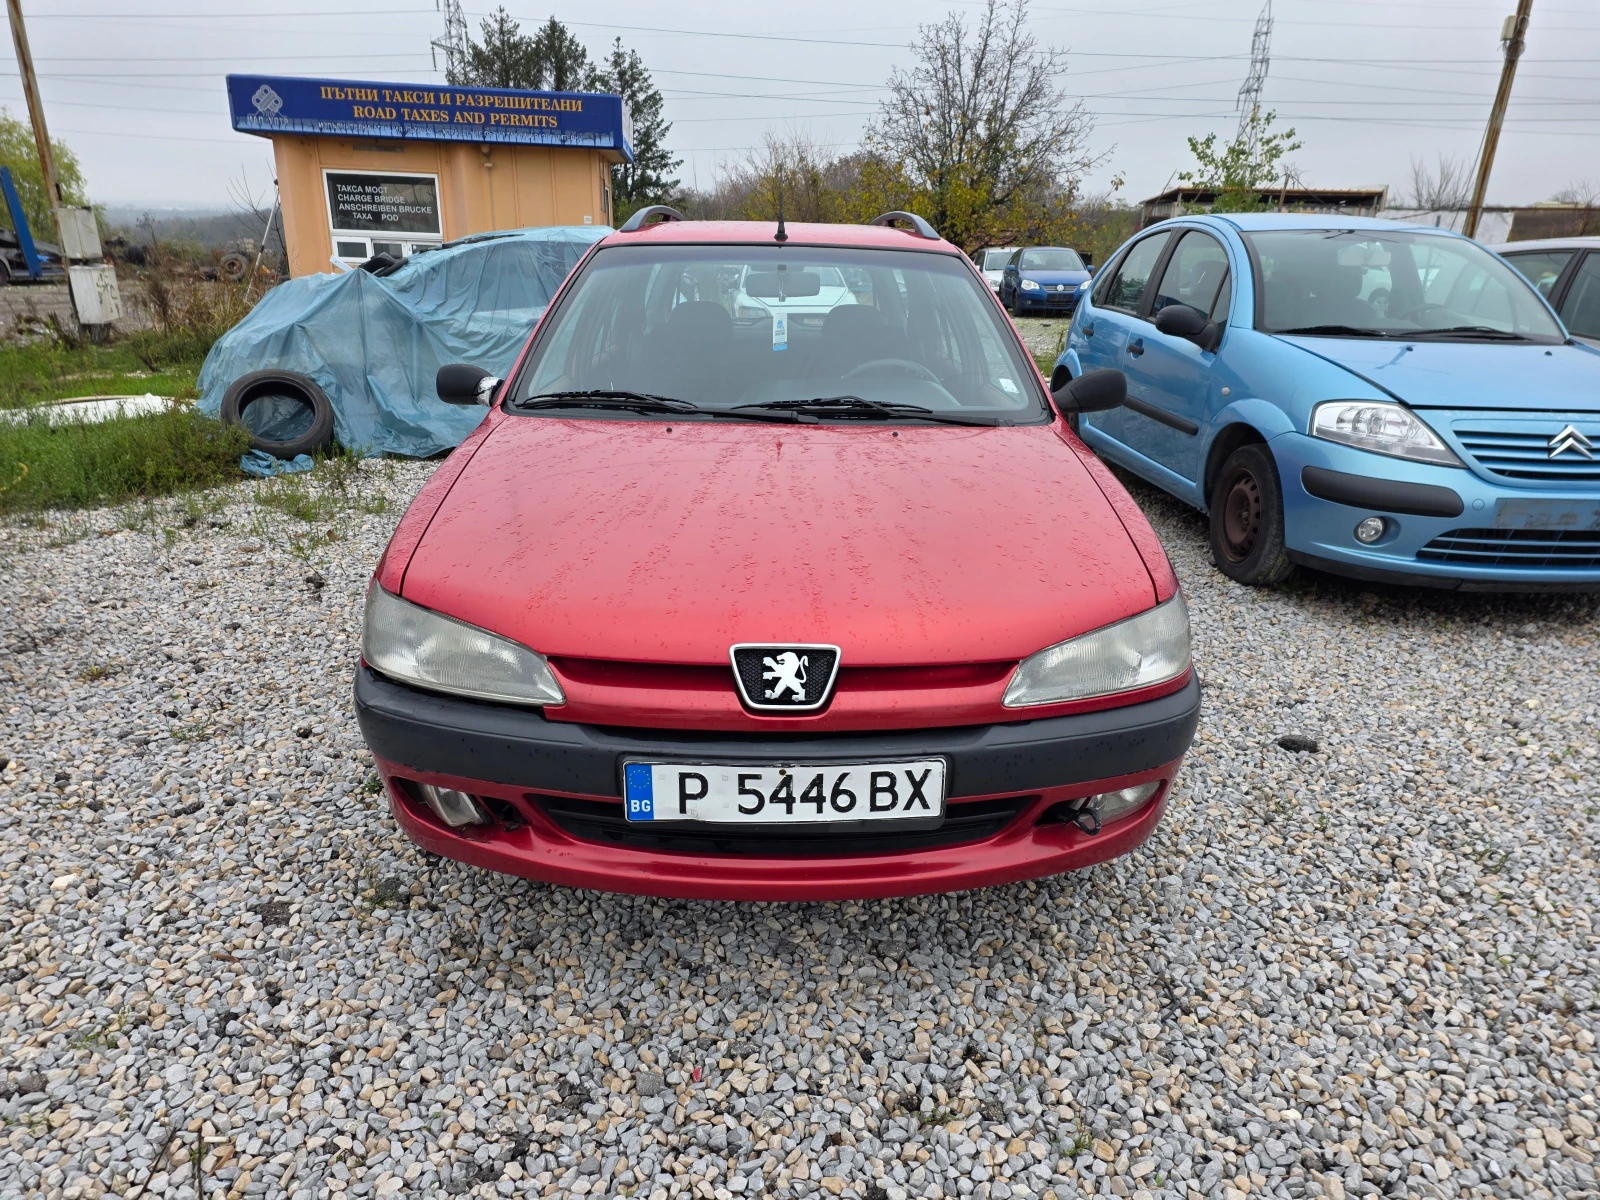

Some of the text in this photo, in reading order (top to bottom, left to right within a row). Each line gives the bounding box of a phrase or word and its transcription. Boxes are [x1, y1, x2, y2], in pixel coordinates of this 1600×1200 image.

[320, 86, 583, 112] ПЪТНИ ТАКСИ И РАЗРЕШИТЕЛНИ
[352, 105, 558, 128] ROAD TAXES AND PERMITS
[336, 184, 388, 194] ТАКСА МОСТ
[337, 193, 405, 204] CHARGE BRIDGE
[339, 203, 433, 214] ANSCHREIBEN BRUCKE
[353, 212, 399, 221] TAXA POD
[678, 768, 932, 815] P 5446 BX
[630, 799, 652, 813] BG
